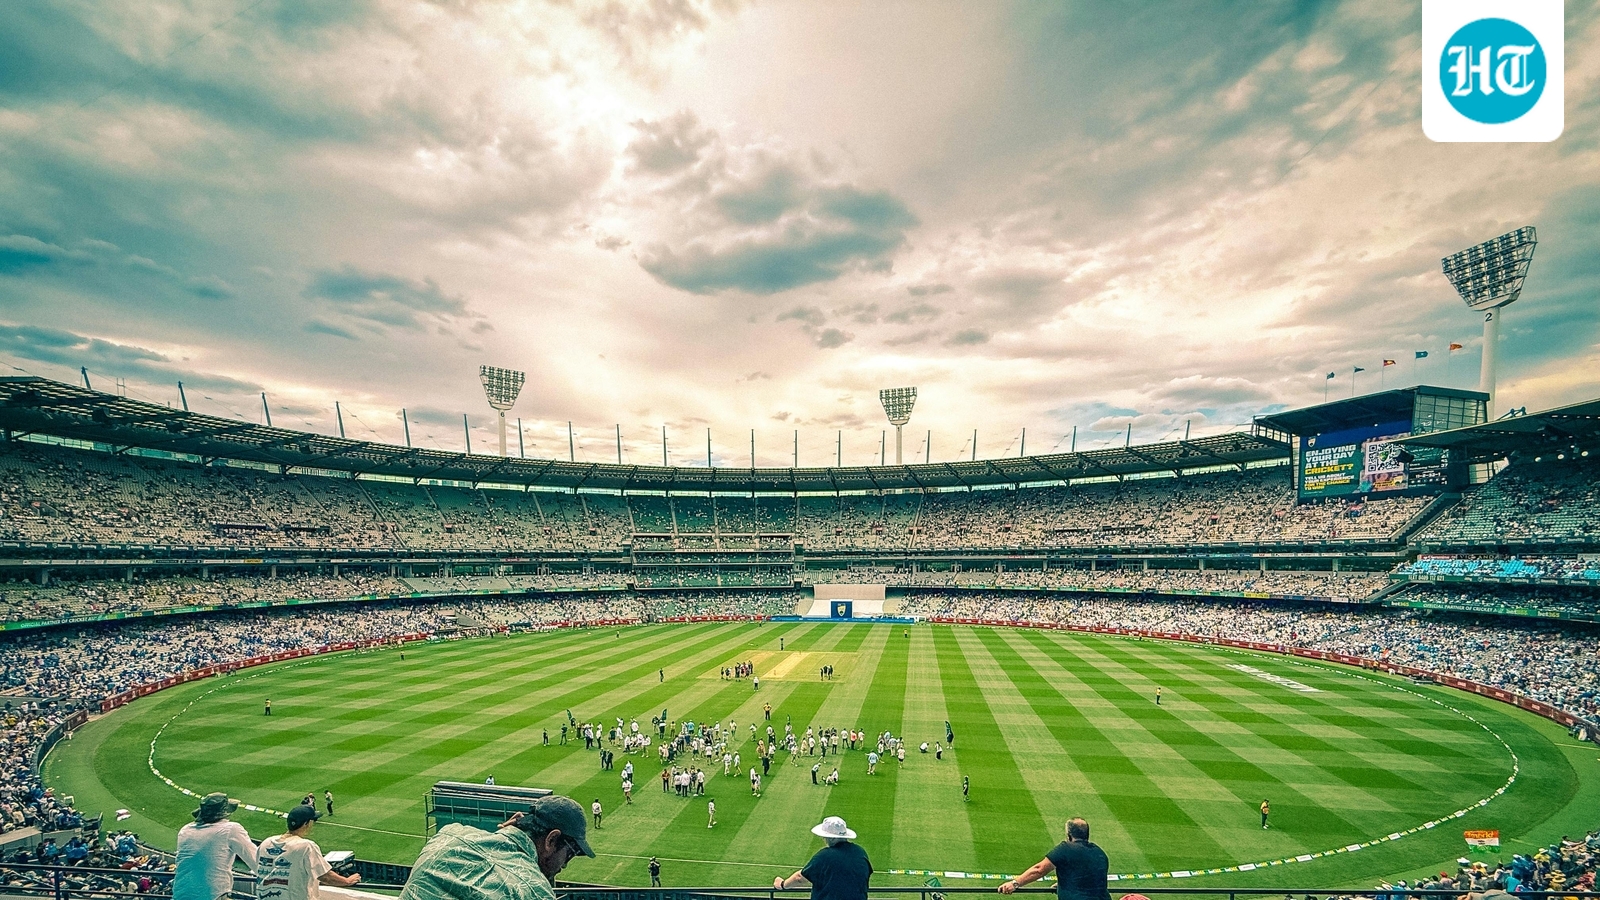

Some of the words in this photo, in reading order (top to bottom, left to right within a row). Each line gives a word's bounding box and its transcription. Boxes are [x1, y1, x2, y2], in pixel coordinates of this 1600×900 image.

[1485, 312, 1493, 322] 2
[1305, 444, 1356, 457] ENJOYING
[1305, 454, 1332, 463] YOUR
[1333, 451, 1354, 460] DAY
[1320, 459, 1339, 467] THE
[1305, 463, 1354, 475] CRICKET?
